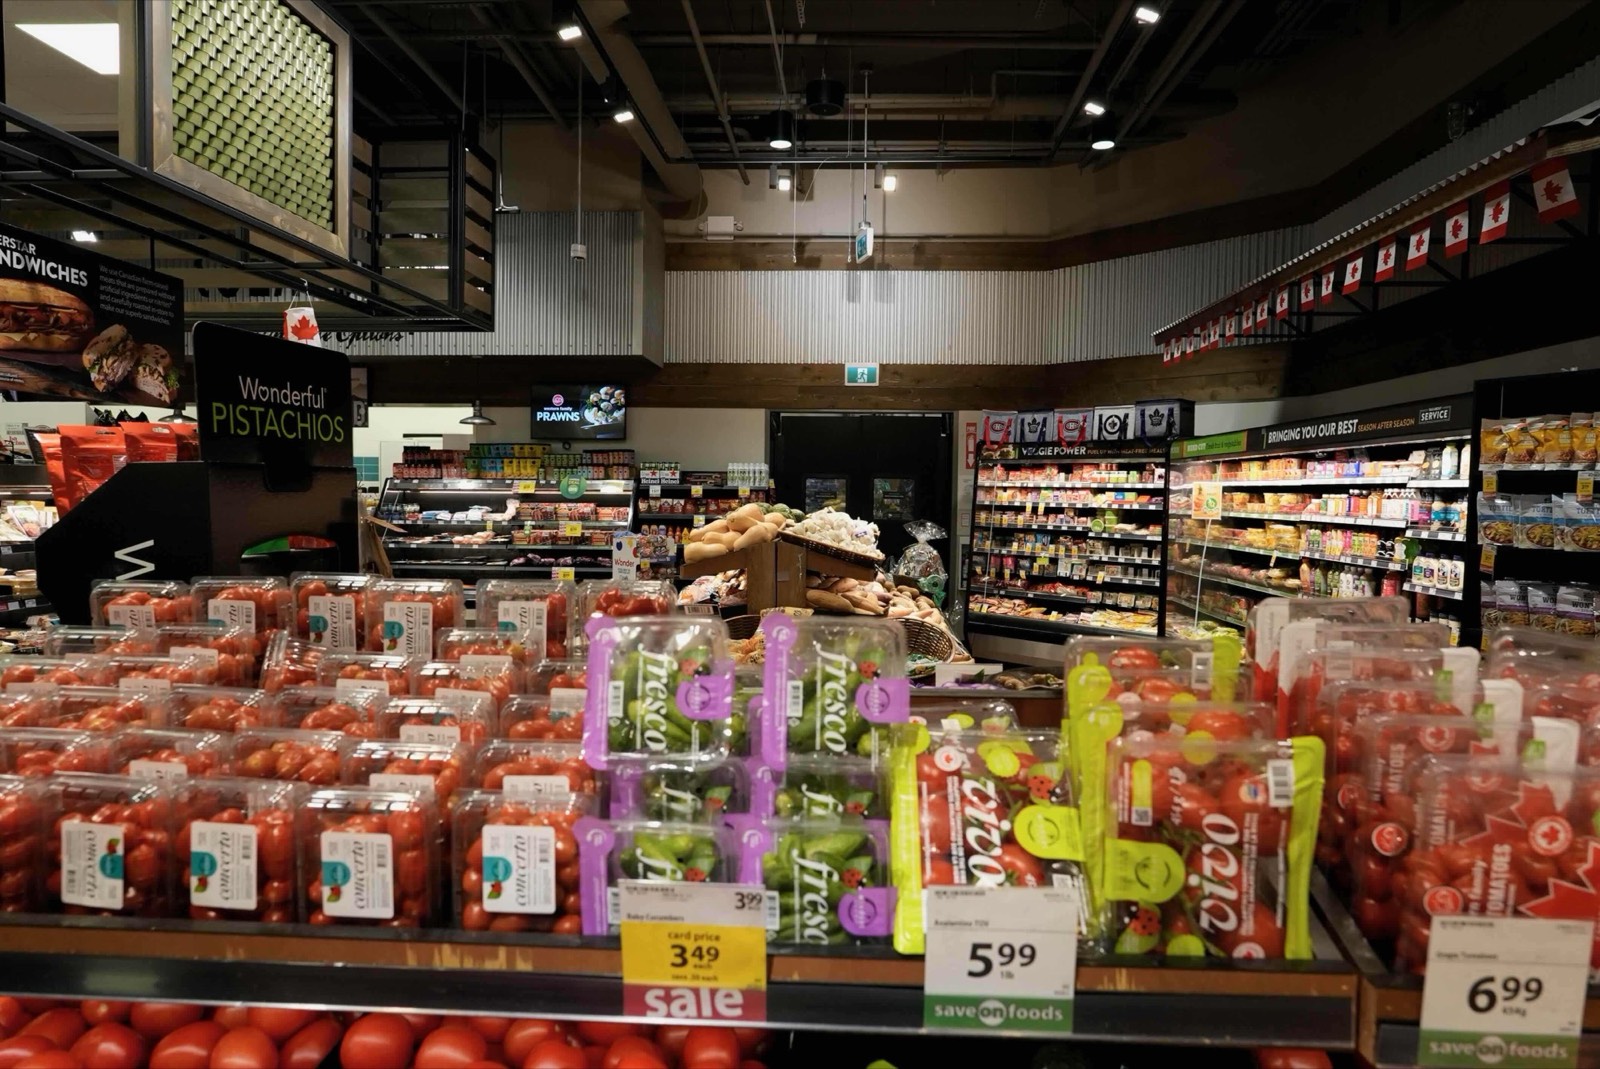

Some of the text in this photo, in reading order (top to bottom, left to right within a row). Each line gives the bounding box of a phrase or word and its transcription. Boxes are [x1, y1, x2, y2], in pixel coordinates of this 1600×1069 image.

[239, 375, 326, 409] Wonderful
[212, 402, 344, 442] PISTACHIOS
[536, 412, 580, 422] PRAWNS
[1268, 418, 1414, 444] BRINGING YOU OUR BEST SEASON AFTER SEASON
[1420, 408, 1448, 422] SERVICE
[1054, 446, 1086, 456] POWER
[637, 643, 679, 752] fresco
[815, 642, 857, 754] fresco
[1188, 813, 1240, 934] vivo
[792, 848, 839, 945] fresc
[668, 931, 720, 943] card price
[644, 988, 744, 1018] sale
